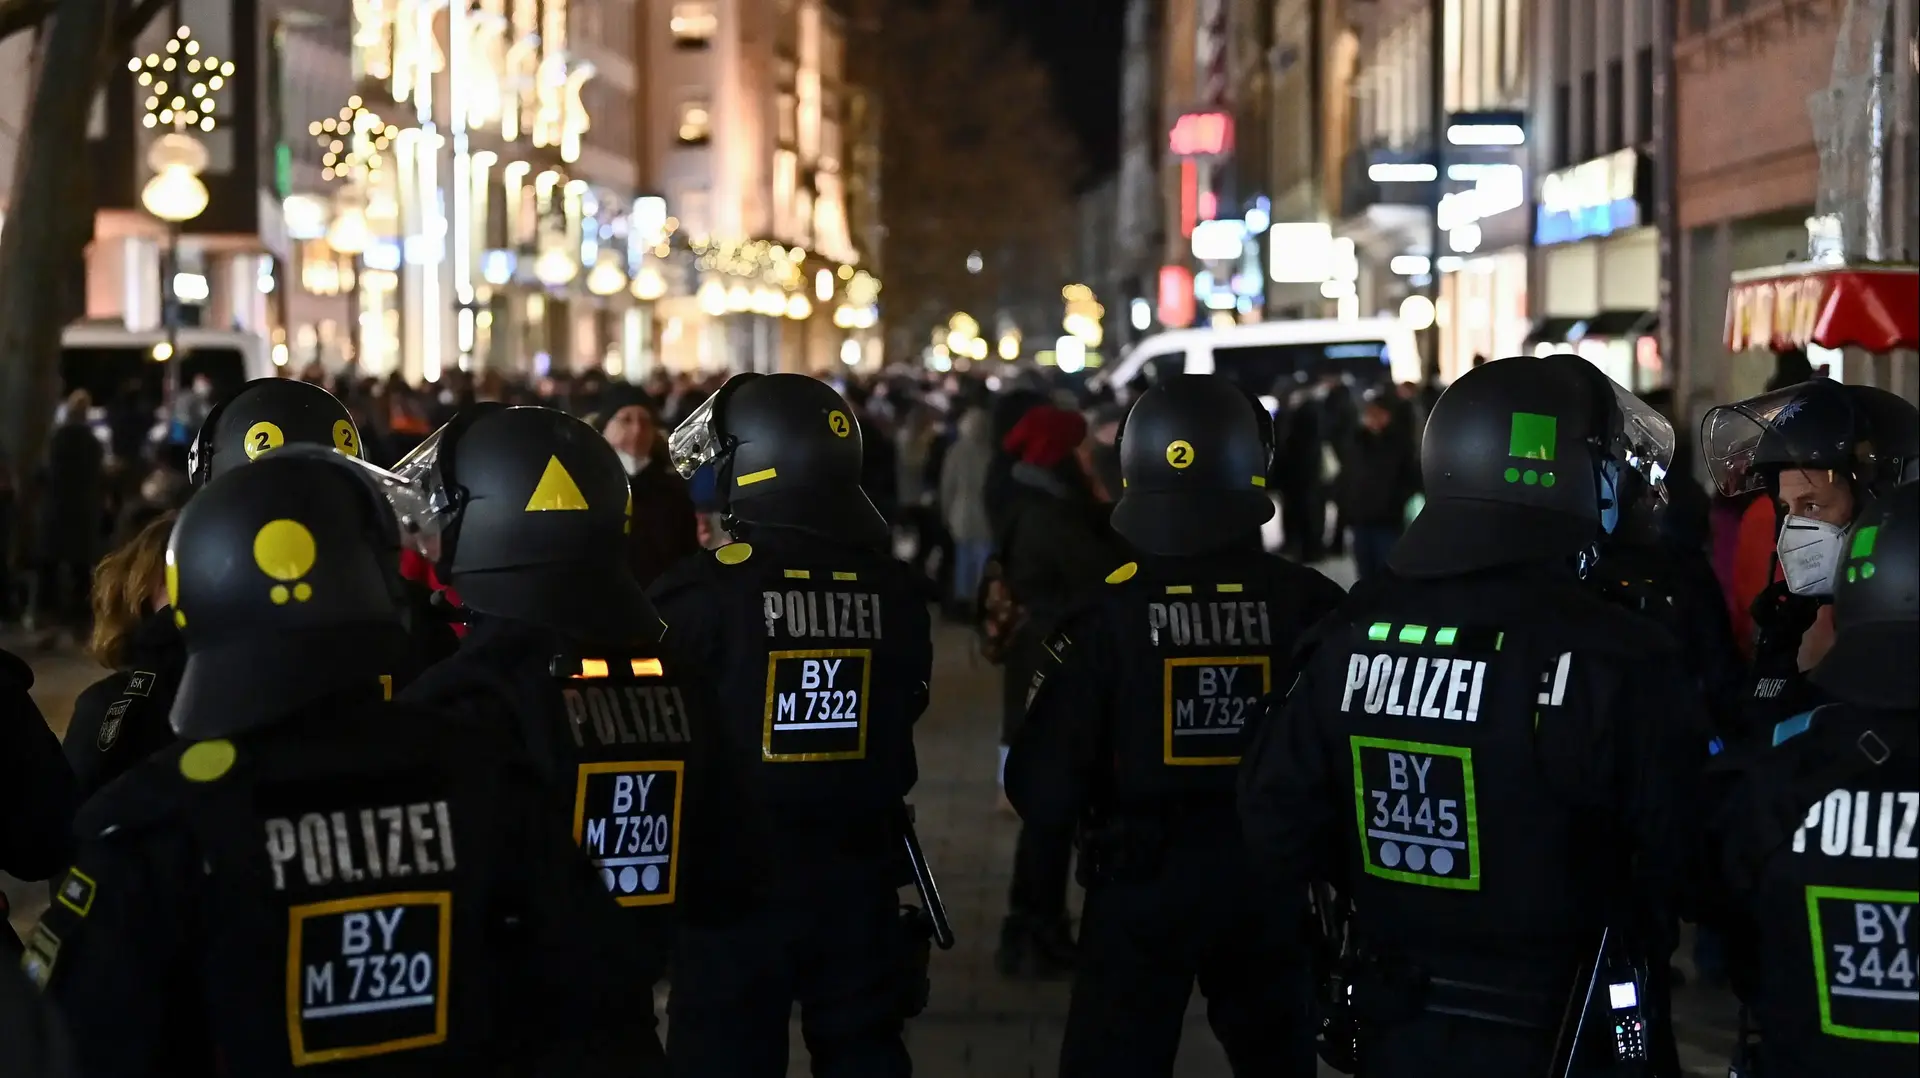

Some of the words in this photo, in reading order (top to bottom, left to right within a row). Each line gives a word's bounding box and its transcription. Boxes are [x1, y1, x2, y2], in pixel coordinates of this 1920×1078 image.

[255, 432, 270, 451] 2
[341, 429, 352, 447] 2
[833, 415, 847, 433] 2
[1172, 446, 1187, 464] 2
[763, 590, 882, 639] POLIZEI
[1149, 601, 1272, 646] POLIZEI
[801, 659, 842, 689] BY
[1198, 667, 1239, 696] BY
[1341, 653, 1487, 722] POLIZEI
[562, 686, 691, 747] POLIZEI
[777, 692, 796, 721] M
[804, 690, 857, 720] 7322
[1176, 699, 1195, 727] M
[1388, 752, 1432, 794] BY
[612, 774, 656, 814] BY
[1371, 790, 1459, 837] 3445
[265, 801, 456, 890] POLIZEI
[586, 818, 606, 856] M
[614, 815, 668, 854] 7320
[342, 907, 404, 955] BY
[1855, 903, 1911, 944] BY
[306, 961, 334, 1005] M
[346, 952, 432, 1000] 7320
[1833, 945, 1920, 988] 344
